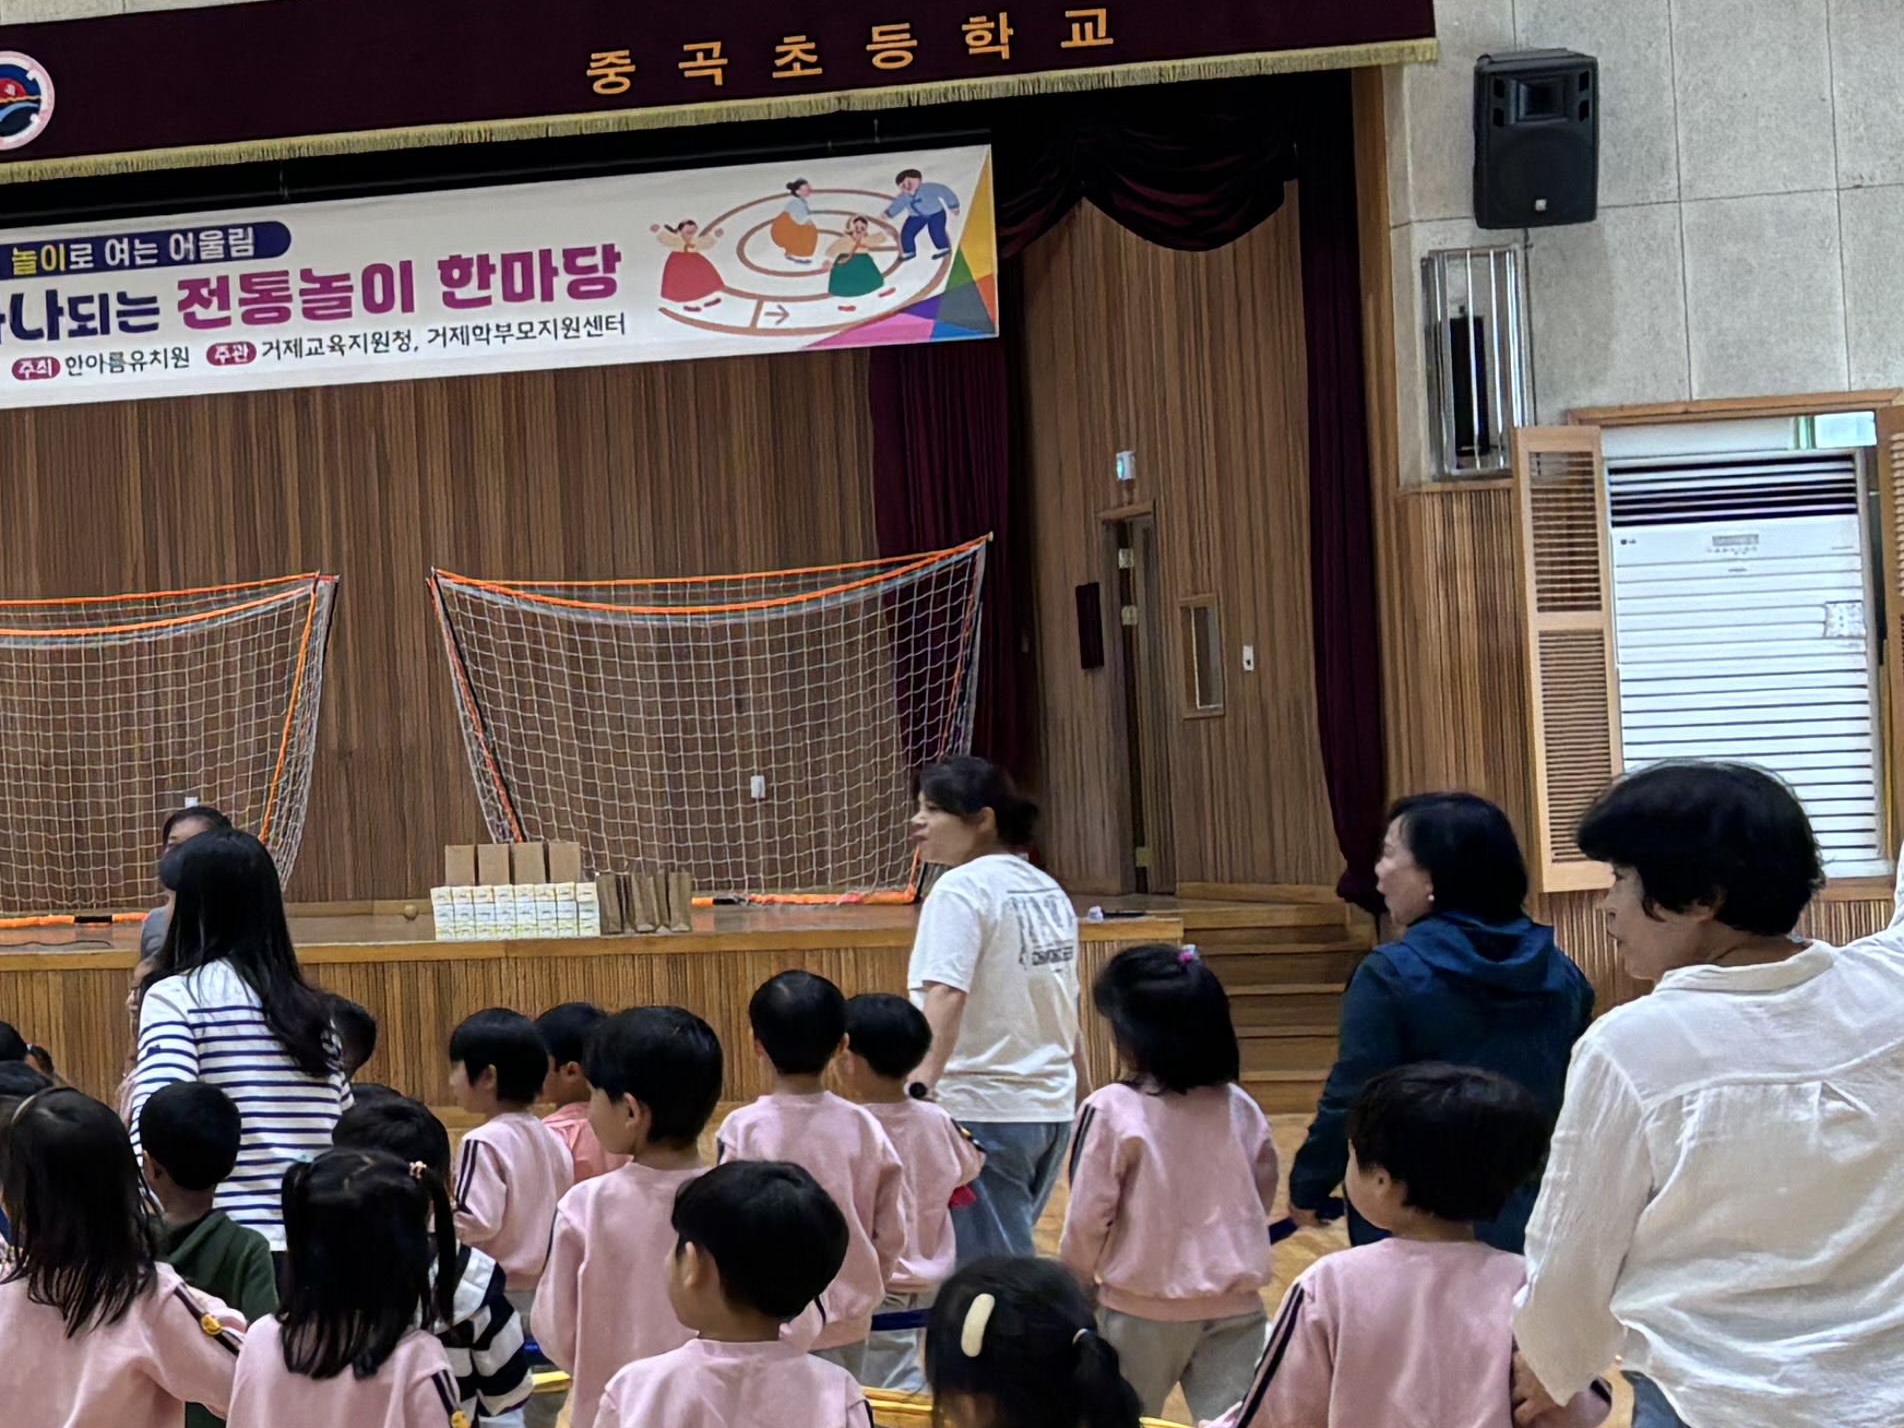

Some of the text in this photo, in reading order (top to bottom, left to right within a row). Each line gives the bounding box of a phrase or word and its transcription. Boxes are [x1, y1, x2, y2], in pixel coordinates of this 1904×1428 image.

[12, 243, 94, 276] 놀이로
[104, 237, 158, 267] 여는
[169, 226, 255, 261] 어울림
[177, 260, 415, 330] 전통놀이
[437, 243, 623, 310] 한마당
[65, 345, 190, 377] 한아름유치원
[213, 341, 250, 364] 주관
[261, 328, 419, 361] 거제교육지원청,
[427, 312, 626, 348] 거제학부모지원센터
